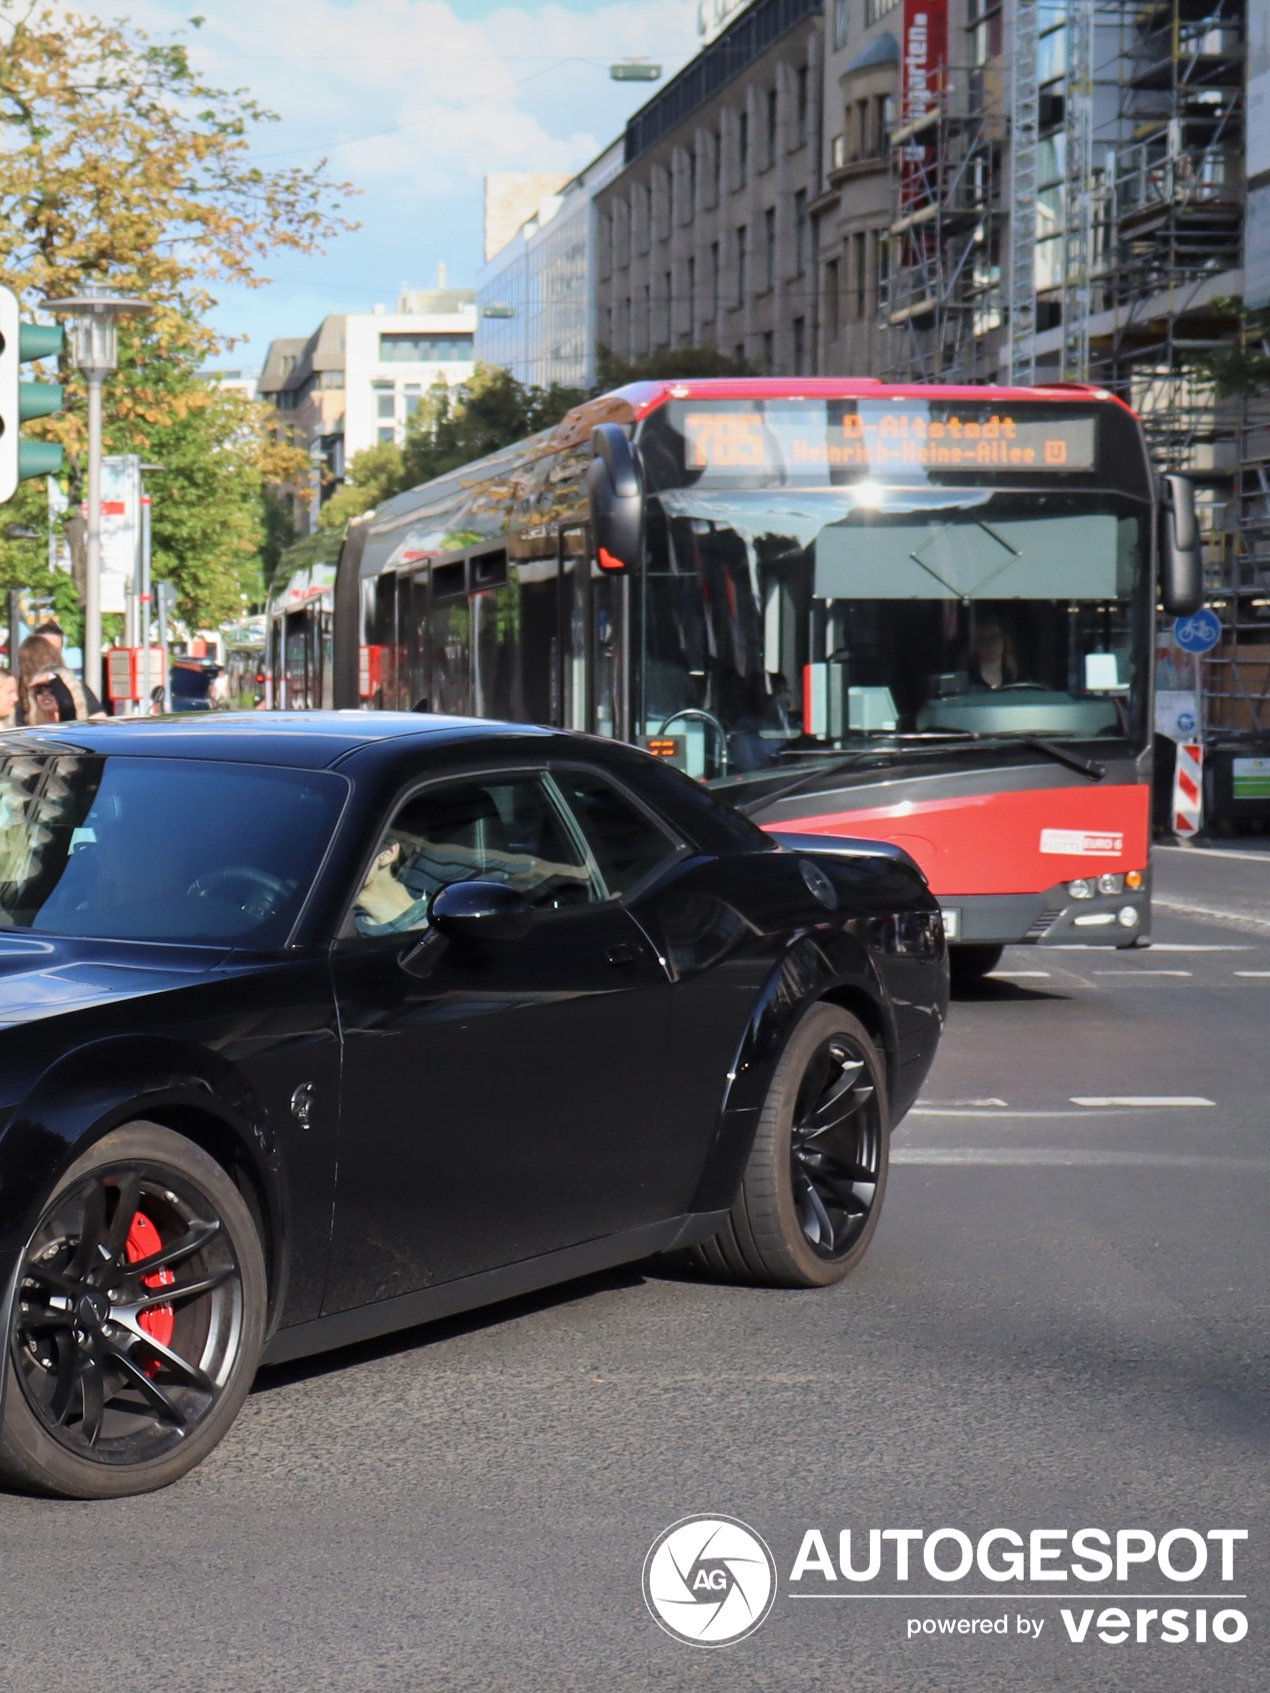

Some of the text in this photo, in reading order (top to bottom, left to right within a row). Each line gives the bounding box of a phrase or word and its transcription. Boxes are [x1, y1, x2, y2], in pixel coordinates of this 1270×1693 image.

[843, 414, 1016, 439] D-Altstadt
[687, 413, 763, 466] 785
[1084, 838, 1122, 850] EURO 6
